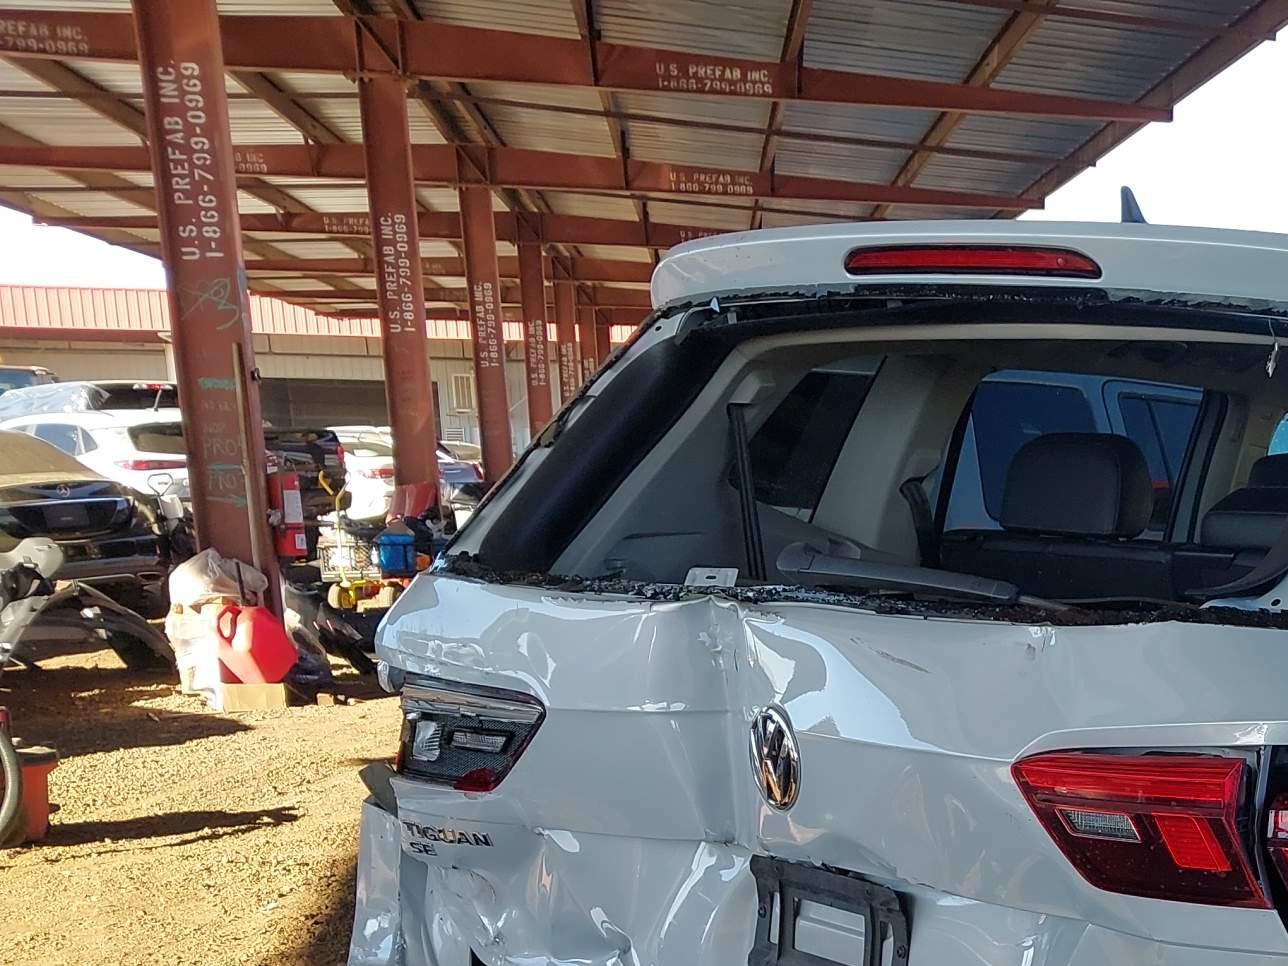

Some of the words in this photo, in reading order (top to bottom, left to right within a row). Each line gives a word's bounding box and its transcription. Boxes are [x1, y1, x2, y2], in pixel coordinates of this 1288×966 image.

[157, 60, 181, 103] INC.
[688, 64, 741, 80] PREFAB
[163, 116, 194, 204] PREFAB
[181, 62, 225, 258] 1-866-799-0969
[179, 218, 201, 260] U.S.
[380, 212, 394, 239] INC.
[383, 246, 399, 300] PREFAB
[394, 214, 416, 332] 1-866-799-0969
[388, 306, 401, 333] U.S.
[402, 821, 495, 847] TIGUAN
[409, 841, 438, 857] SE
